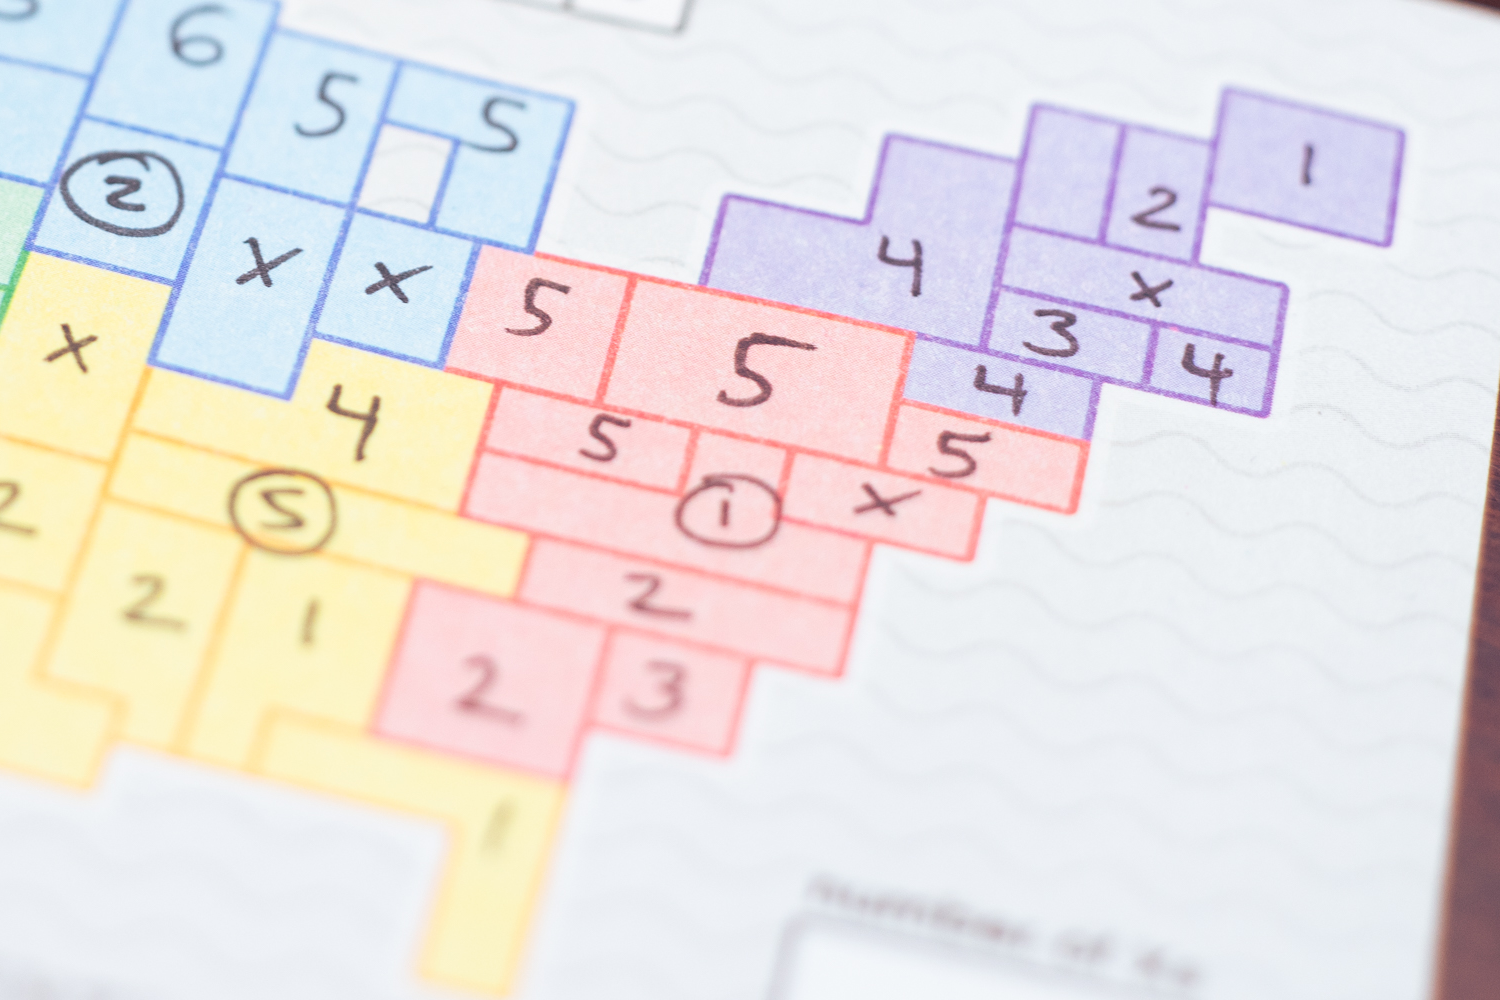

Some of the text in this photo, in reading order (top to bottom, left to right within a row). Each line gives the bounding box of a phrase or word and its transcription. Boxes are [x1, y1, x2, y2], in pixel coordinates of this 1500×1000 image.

[168, 4, 232, 67] 6
[295, 72, 358, 137] 5
[466, 97, 530, 154] 5
[1131, 187, 1182, 233] 2
[877, 234, 924, 298] 4
[503, 277, 572, 337] 5
[1022, 308, 1081, 358] 3
[716, 331, 818, 408] 5
[972, 364, 1029, 417] 4
[1182, 343, 1233, 405] 4
[327, 383, 382, 462] 4
[578, 413, 632, 462] 5
[928, 430, 992, 480] 5
[260, 488, 305, 529] 5
[122, 573, 188, 633] 2
[625, 572, 693, 622] 2
[454, 653, 528, 728] 2
[623, 659, 690, 722] 3
